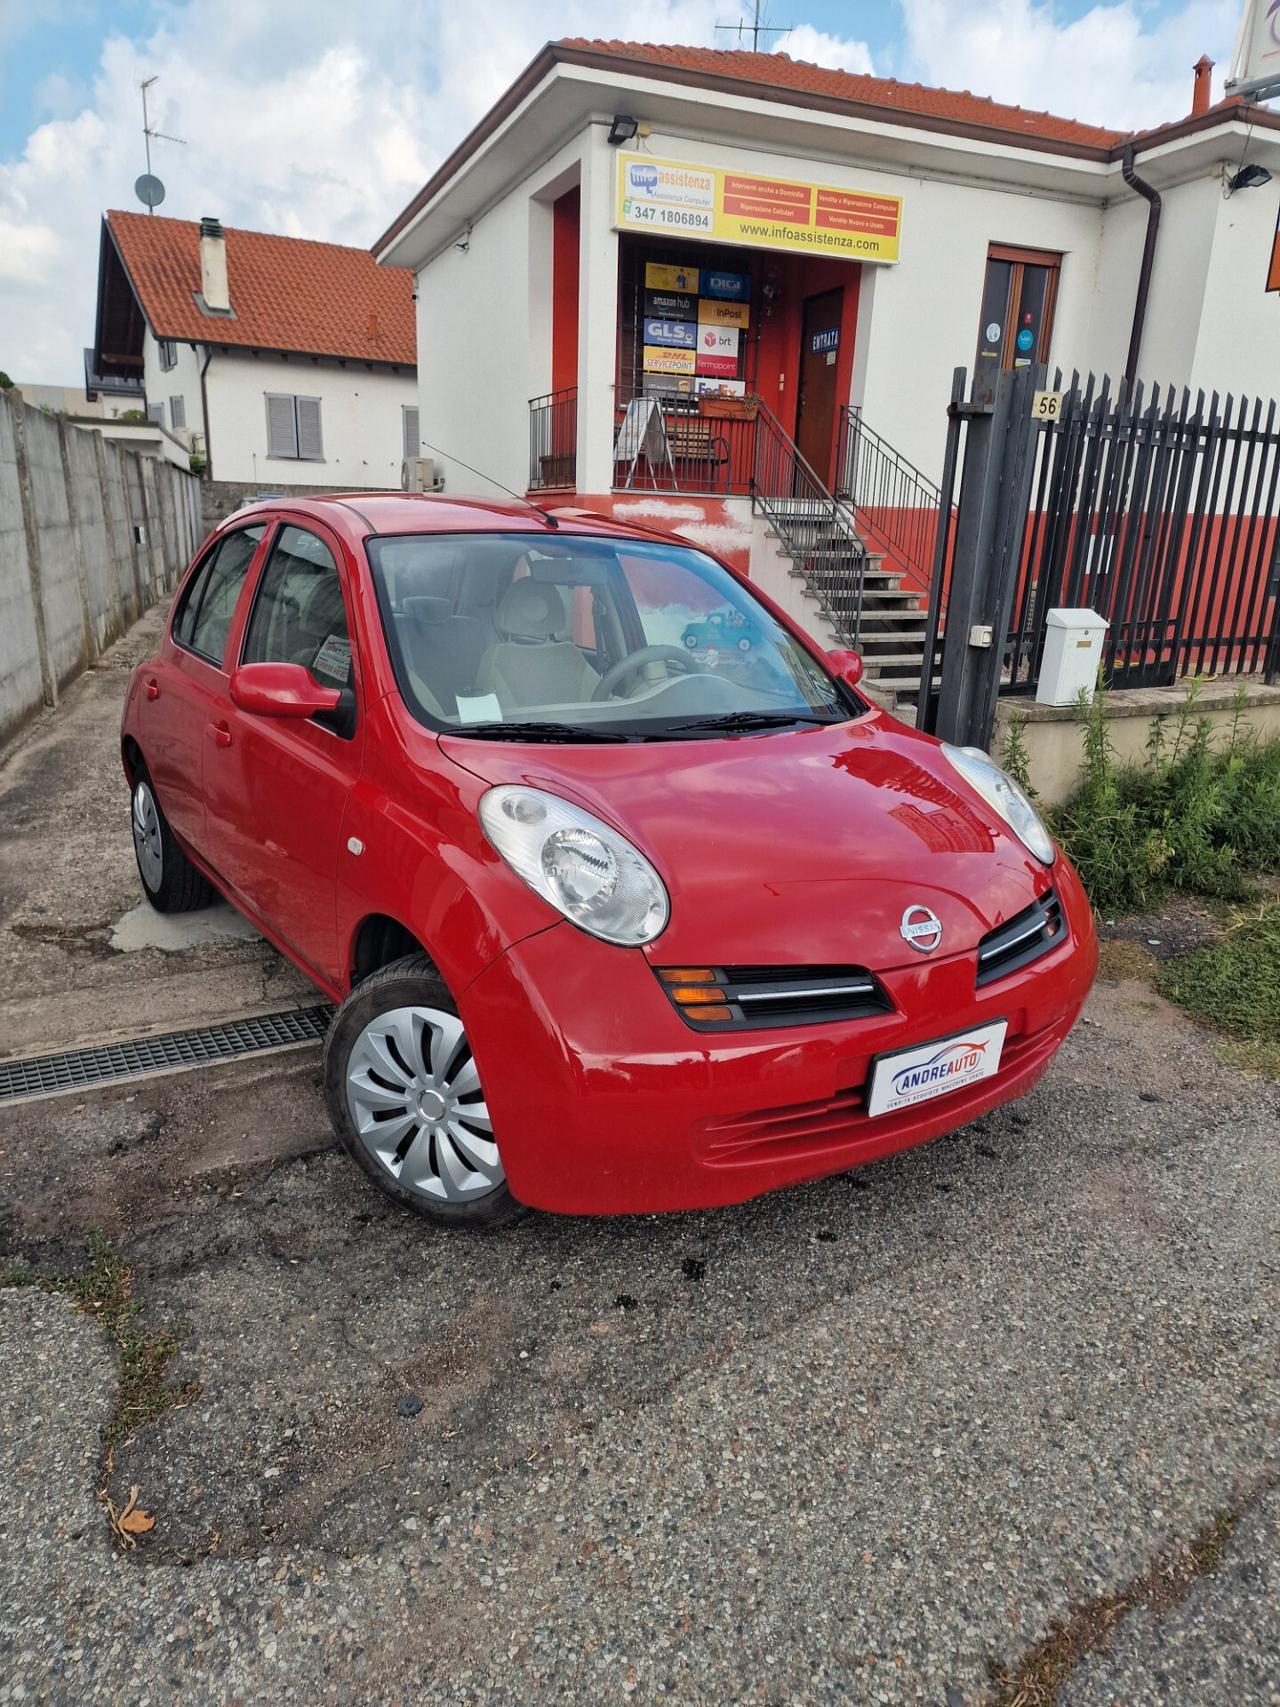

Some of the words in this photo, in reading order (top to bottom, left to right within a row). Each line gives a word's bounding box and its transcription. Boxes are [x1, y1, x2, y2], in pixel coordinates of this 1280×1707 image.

[659, 171, 711, 190] assistenza
[732, 182, 757, 192] Interventi
[758, 186, 773, 194] anche
[780, 188, 804, 198] Domicilio
[654, 191, 682, 202] Assistenza
[684, 196, 711, 206] Computer
[818, 194, 837, 204] Vendita
[843, 198, 872, 209] Riparazione
[873, 202, 897, 212] Computer
[635, 206, 656, 220] 347
[660, 209, 709, 227] 1806894
[740, 202, 772, 214] Riparazione
[773, 207, 794, 217] Cellulari
[829, 215, 848, 225] Vendita
[849, 218, 865, 227] Nuovo
[870, 221, 885, 230] Usato
[740, 223, 879, 251] www.infoassistenza.com
[710, 278, 740, 289] DIGI
[653, 296, 676, 308] amazon
[677, 296, 690, 309] hub
[716, 308, 741, 319] InPost
[648, 322, 685, 339] GLS
[719, 336, 731, 346] brt
[812, 330, 838, 351] ENTRATA
[660, 351, 688, 360] DHL
[647, 359, 692, 371] SERVICEPOINT
[1039, 397, 1057, 415] 56
[902, 1053, 977, 1090] ANDREAUTO
[887, 1098, 911, 1108] VENDITA
[913, 1087, 939, 1100] ACQUISTO
